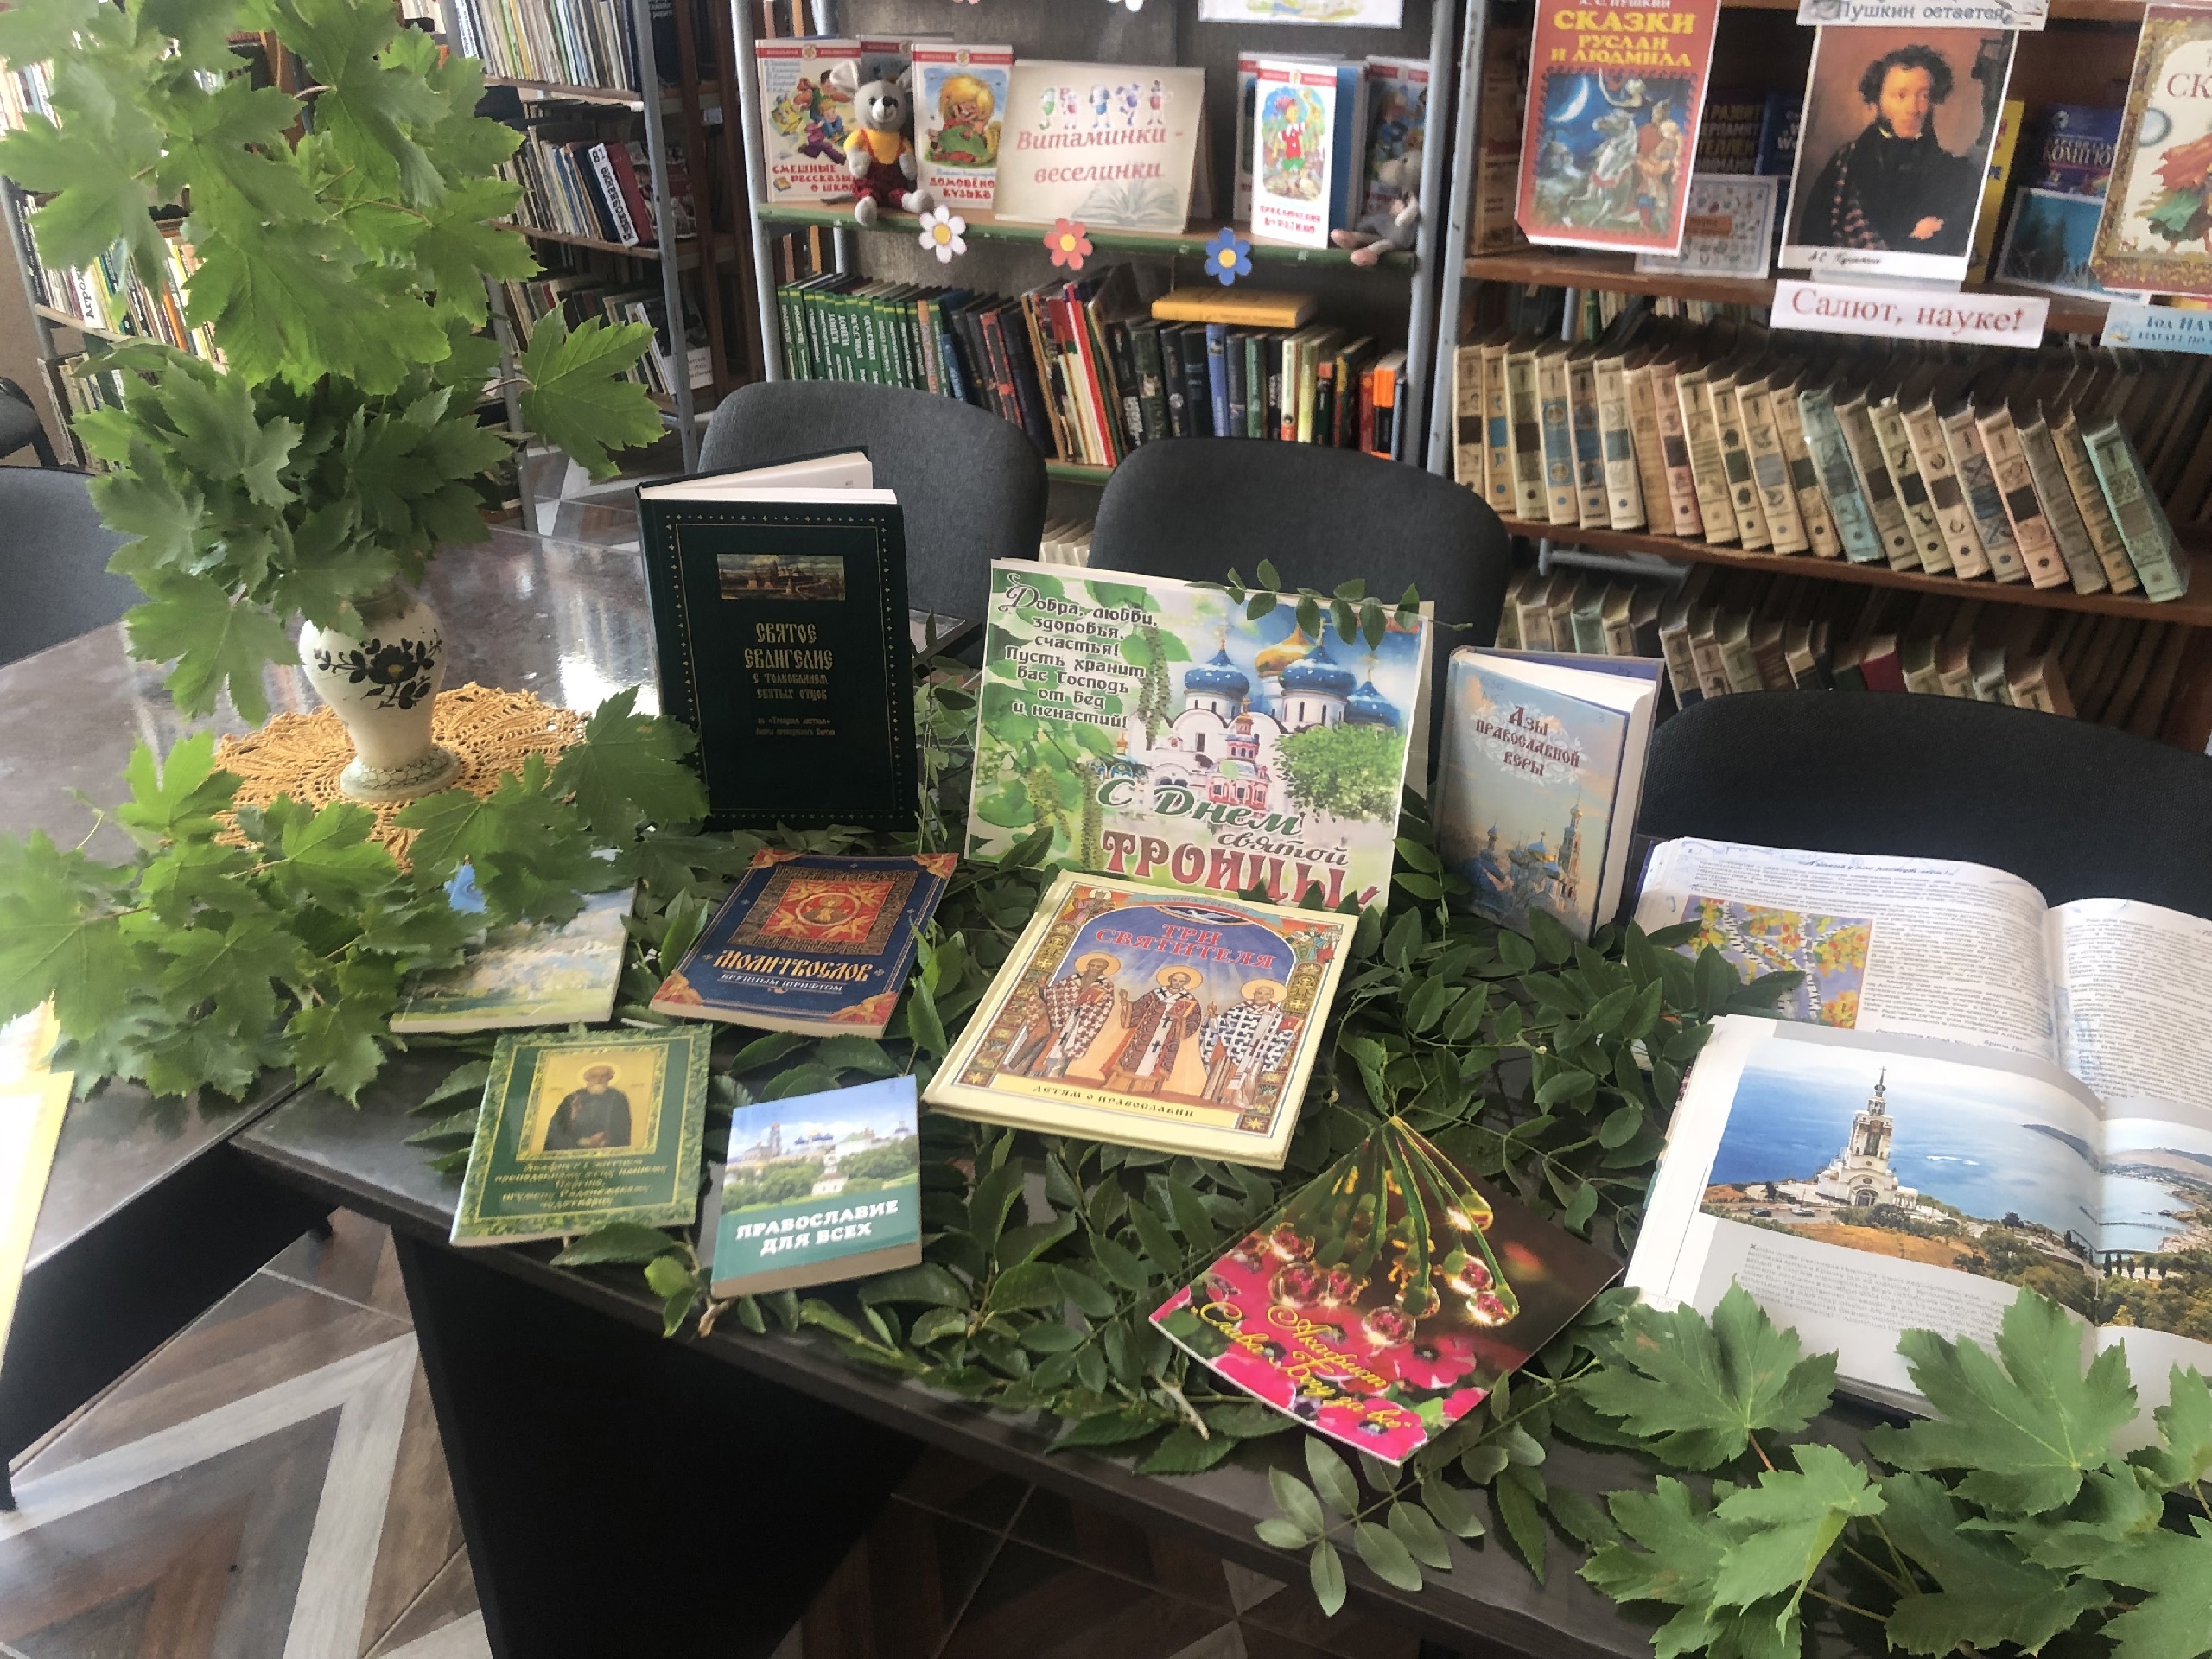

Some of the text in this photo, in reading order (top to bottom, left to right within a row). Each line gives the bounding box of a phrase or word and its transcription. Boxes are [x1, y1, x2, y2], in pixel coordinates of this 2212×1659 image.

[1553, 10, 1696, 34] СКАЗКИ
[1578, 35, 1669, 51] РУСЛАН
[1550, 48, 1692, 67] И ЛЮДМИЛА
[1016, 128, 1166, 151] Витаминки
[930, 177, 995, 188] ДОМОВЁНО
[1034, 162, 1162, 183] веселинки
[1791, 287, 2024, 335] Салют, науке!
[998, 572, 1159, 627] Добра, любви,
[755, 622, 817, 643] СВЯТОЕ
[1033, 616, 1125, 640] здоровья,
[1034, 635, 1121, 657] счастья!
[744, 648, 833, 670] ЕВАНГЕЛИЕ
[1005, 645, 1146, 678] Пусть хранит
[1056, 670, 1130, 695] Господь
[1039, 688, 1105, 709] от бед
[1013, 702, 1128, 728] и ненастий!
[1509, 705, 1549, 736] Азы
[1096, 779, 1137, 807] С
[1218, 831, 1350, 867] святой
[1161, 923, 1224, 946] ТРИ
[1096, 928, 1277, 969] СВЯТИТЕЛЯ
[1033, 1085, 1082, 1098] ДЕТЯМ
[1097, 1096, 1195, 1118] ПРАВОСЛАВИИ
[735, 1199, 899, 1240] ПРАВОСЛАВИЕ
[760, 1222, 872, 1257] ДЛЯ ВСЕХ
